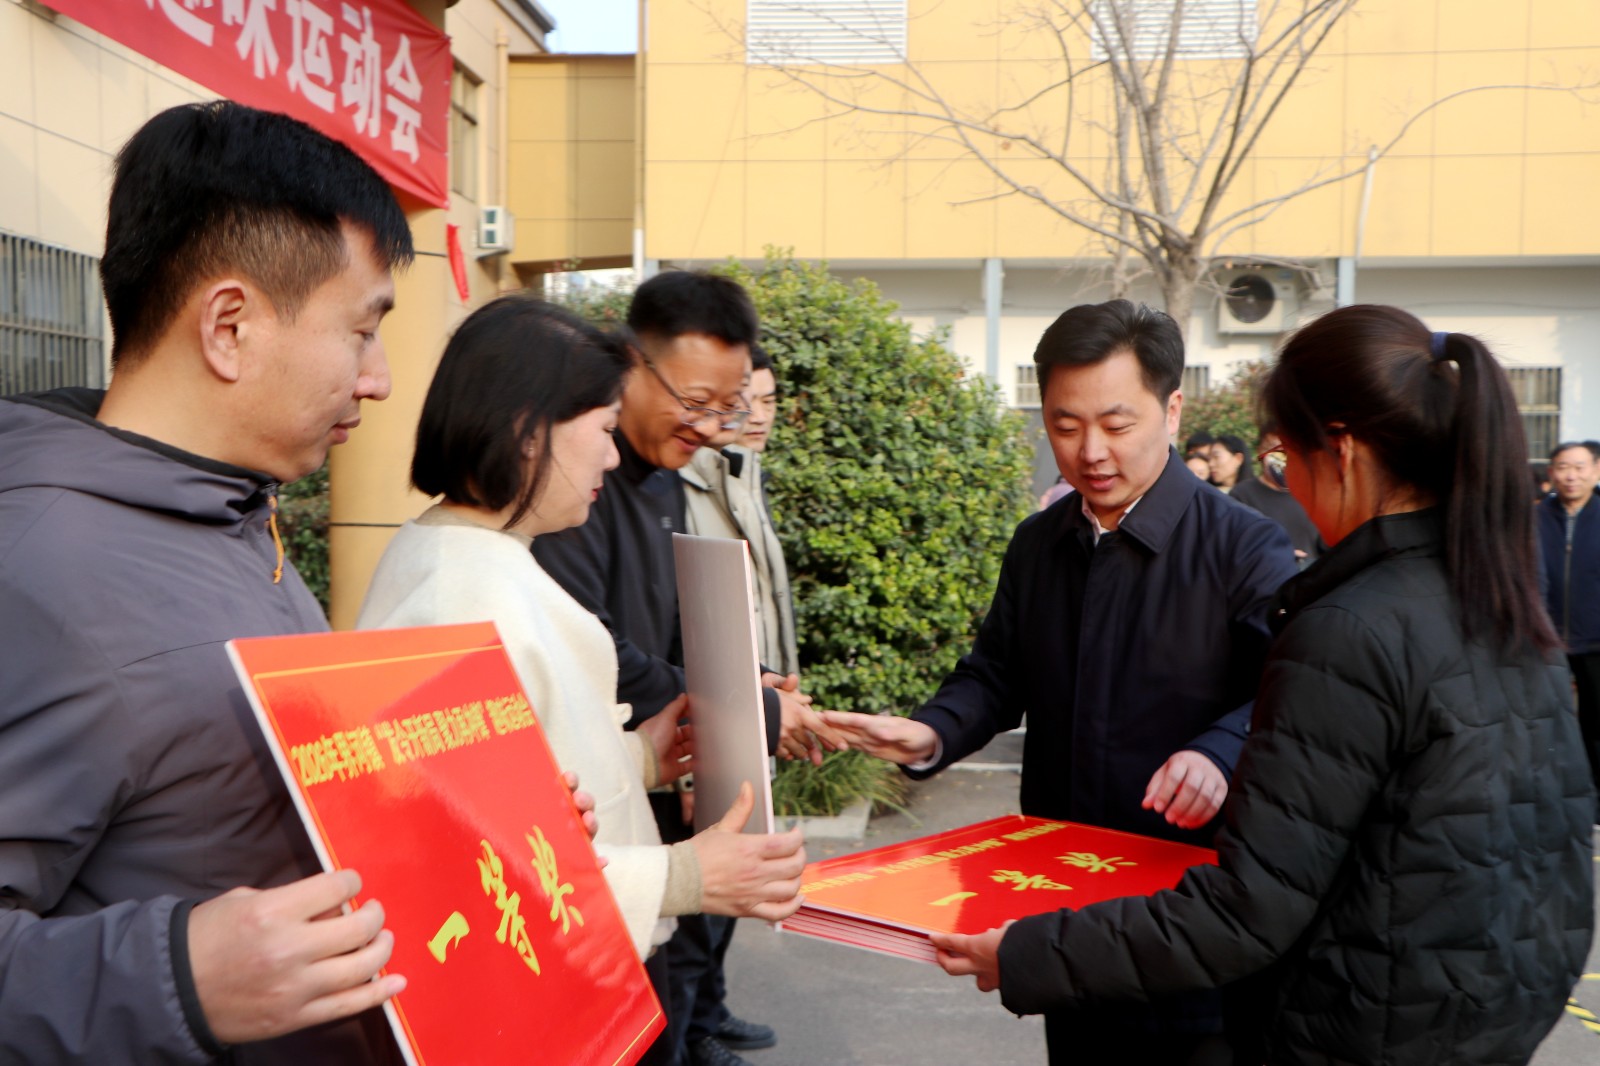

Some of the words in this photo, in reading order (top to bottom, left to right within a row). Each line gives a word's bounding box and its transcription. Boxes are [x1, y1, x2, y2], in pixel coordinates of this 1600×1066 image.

[427, 825, 584, 976] 一等奖
[928, 851, 1138, 906] 一等奖
